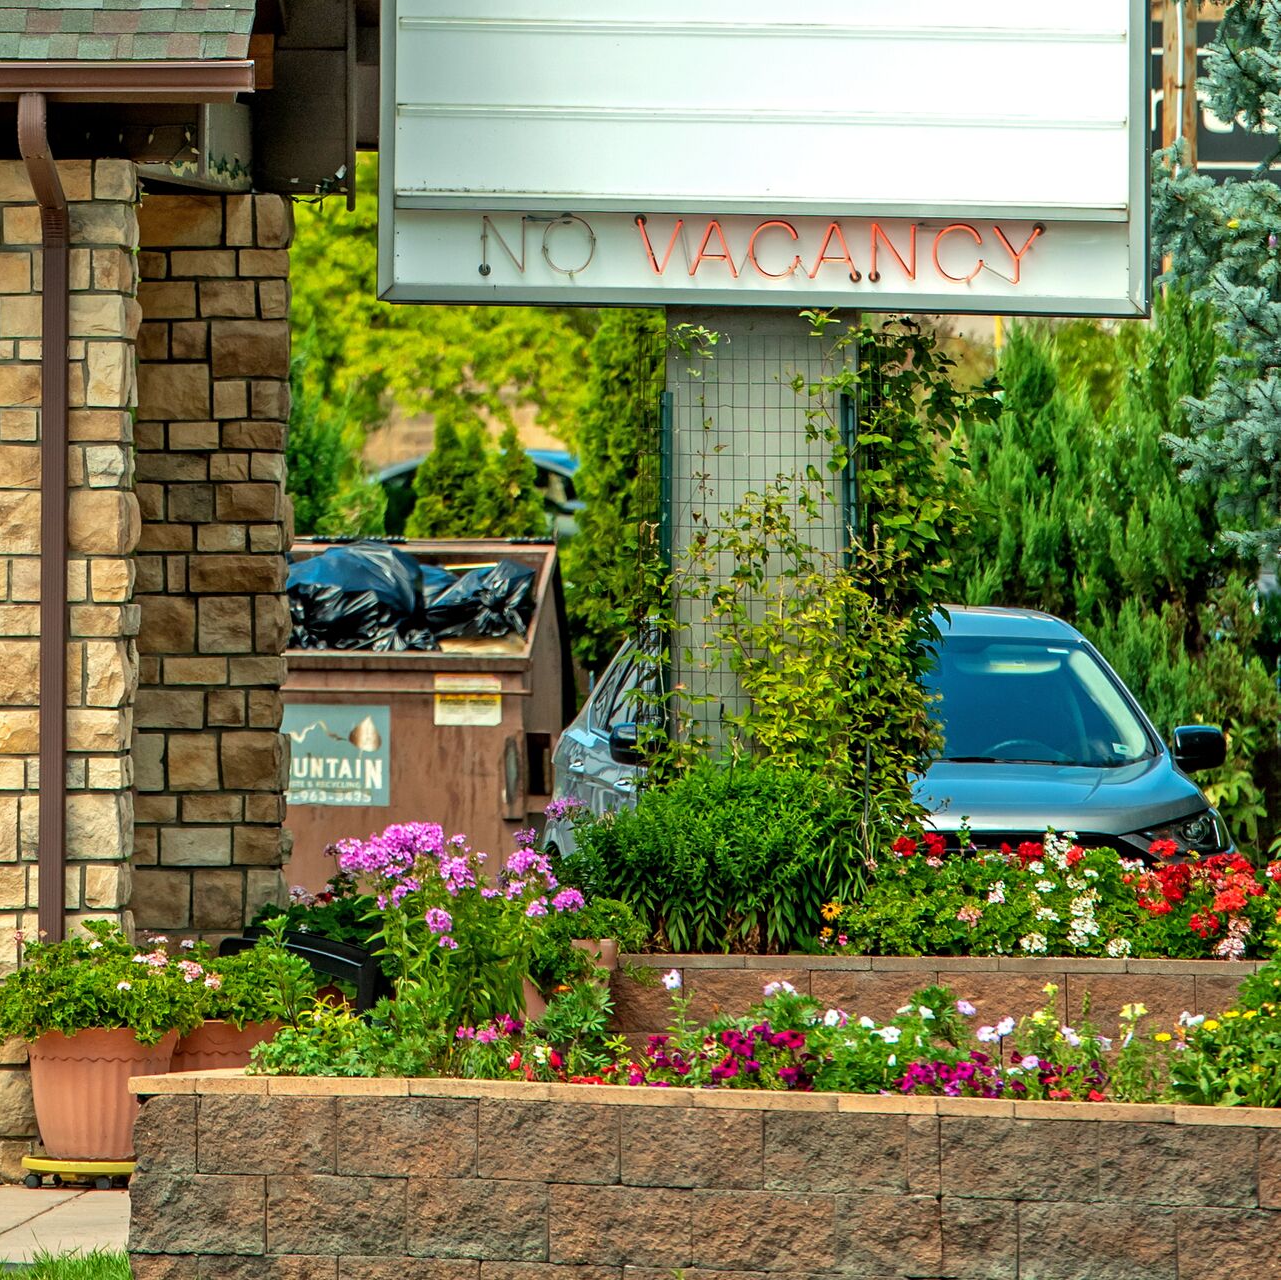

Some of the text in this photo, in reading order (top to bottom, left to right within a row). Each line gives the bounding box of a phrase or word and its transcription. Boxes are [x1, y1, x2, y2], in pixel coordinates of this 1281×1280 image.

[482, 215, 1046, 284] NO VACANCY
[289, 757, 383, 789] UNTAIN
